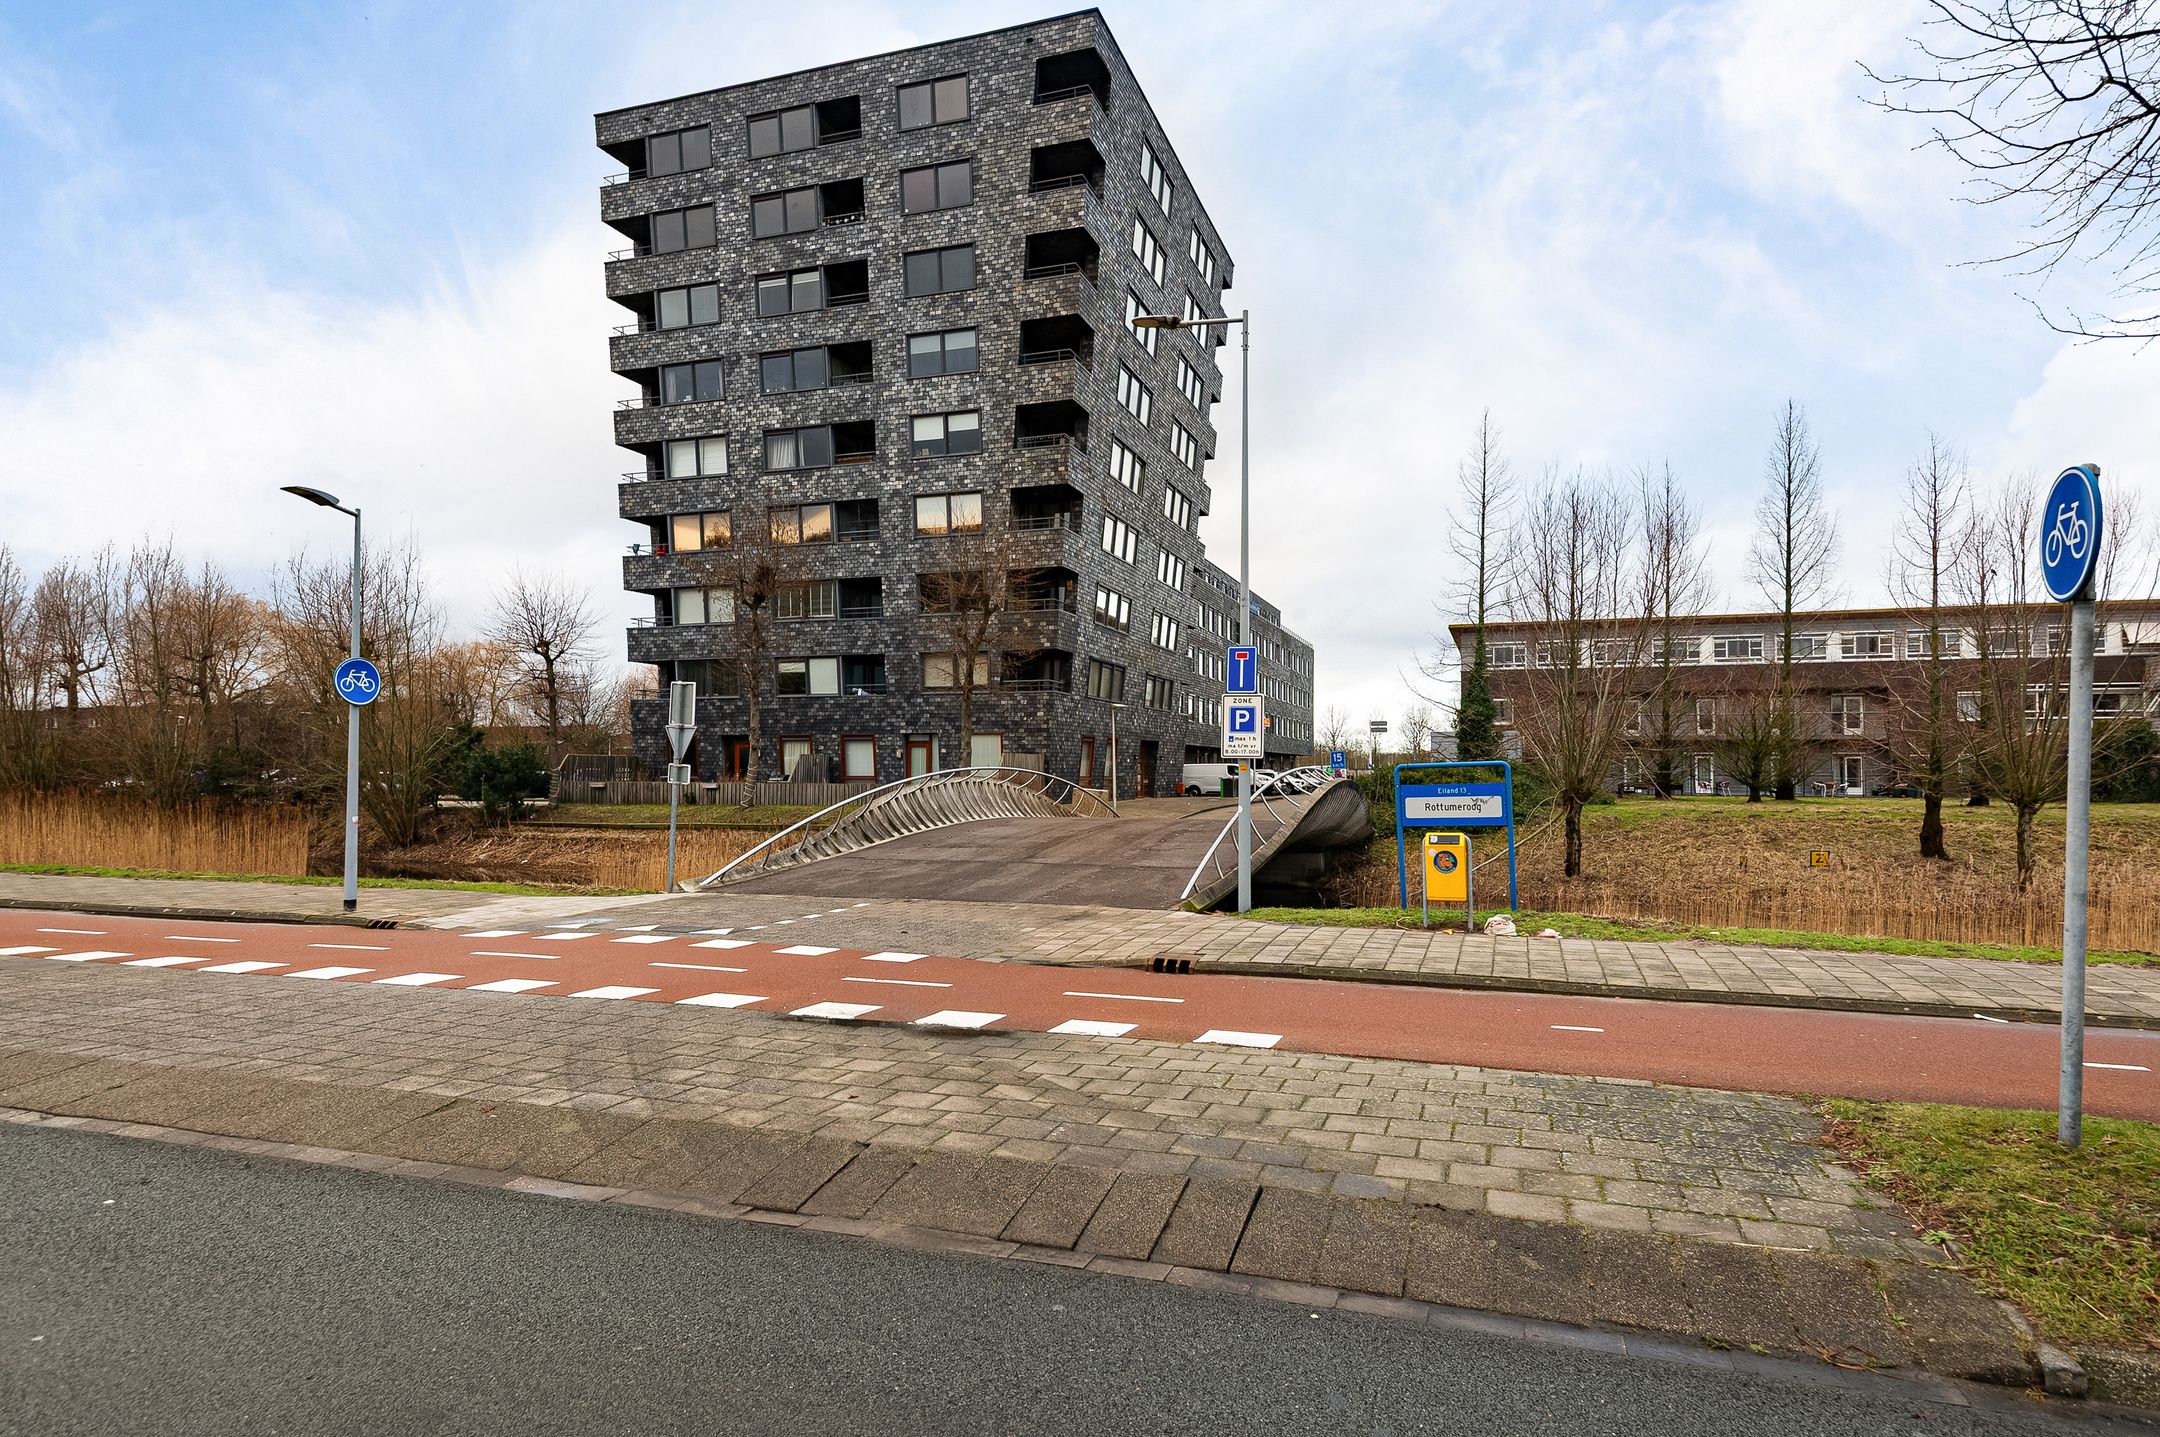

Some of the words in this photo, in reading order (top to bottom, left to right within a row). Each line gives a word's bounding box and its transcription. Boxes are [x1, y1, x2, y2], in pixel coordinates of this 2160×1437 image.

[1235, 710, 1250, 730] P
[1333, 753, 1342, 762] 15
[1425, 803, 1482, 813] Rottumeroog
